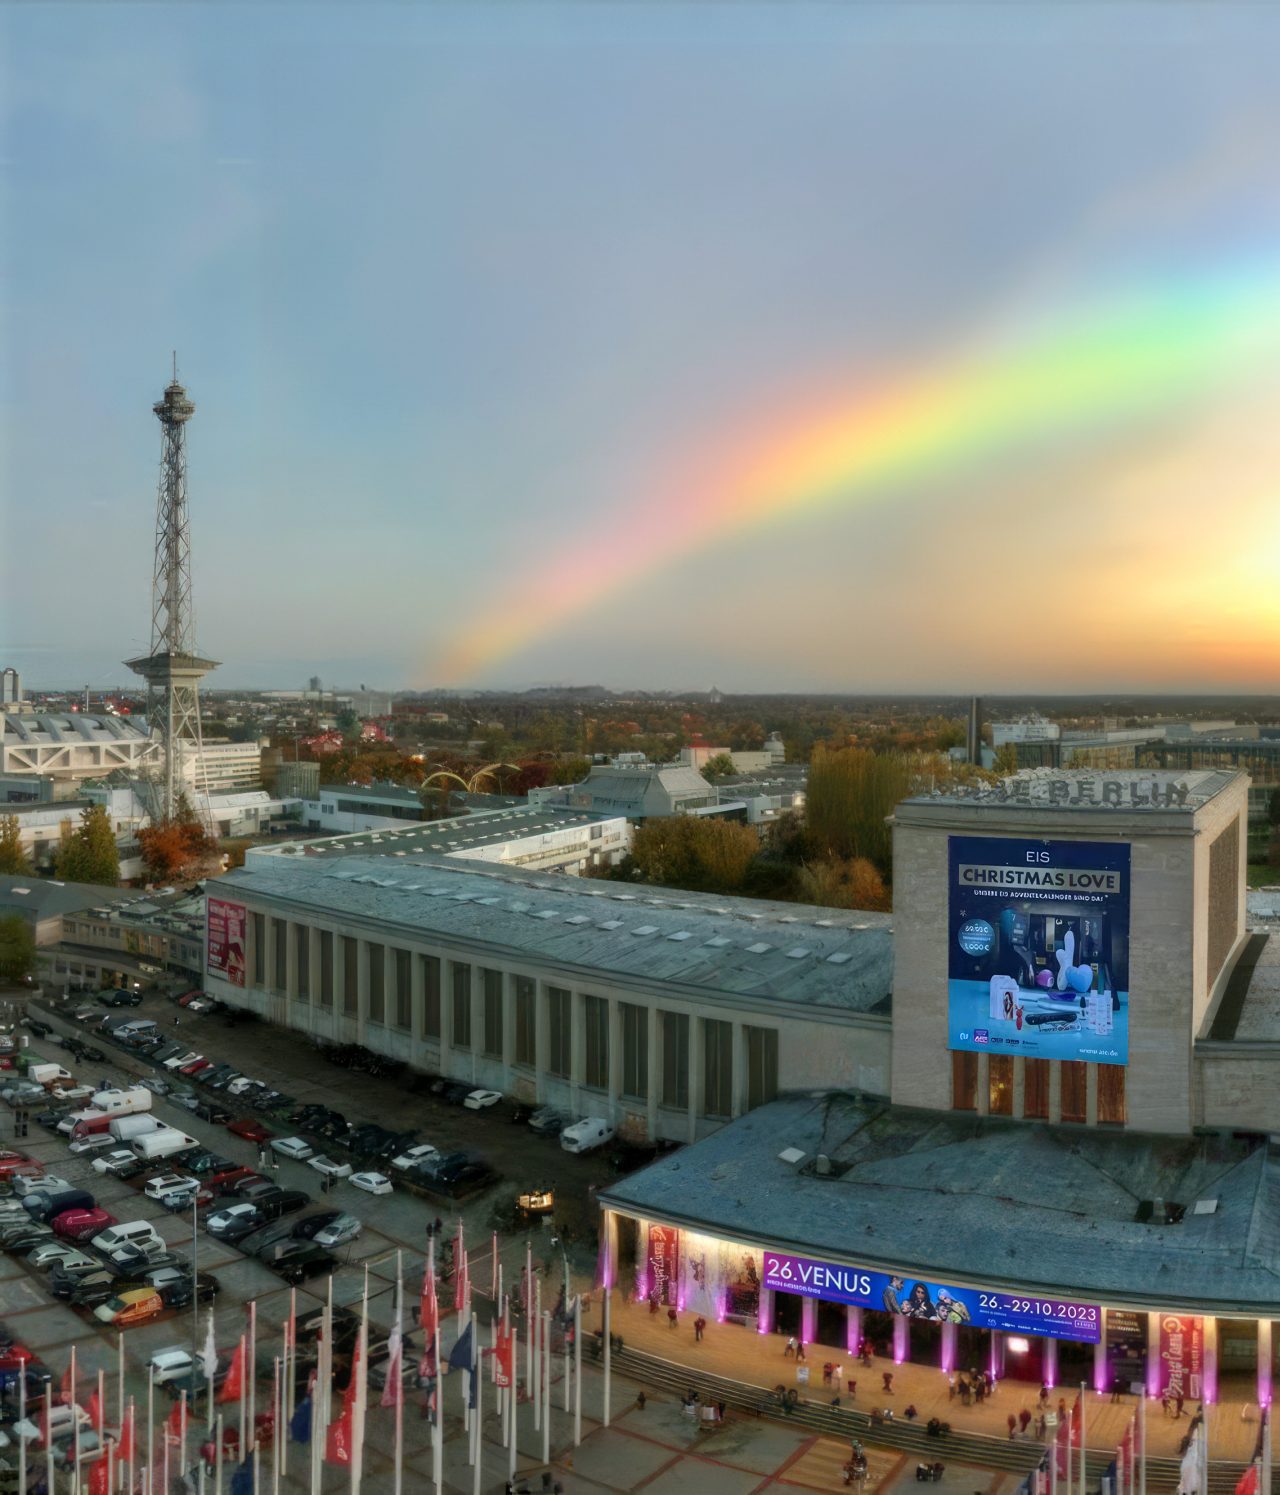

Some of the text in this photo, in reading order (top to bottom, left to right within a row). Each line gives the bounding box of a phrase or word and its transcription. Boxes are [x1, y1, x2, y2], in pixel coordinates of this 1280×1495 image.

[1049, 779, 1188, 808] BERLIN
[1026, 851, 1050, 863] EIS
[963, 868, 1115, 889] CHRISTMAS LOVE
